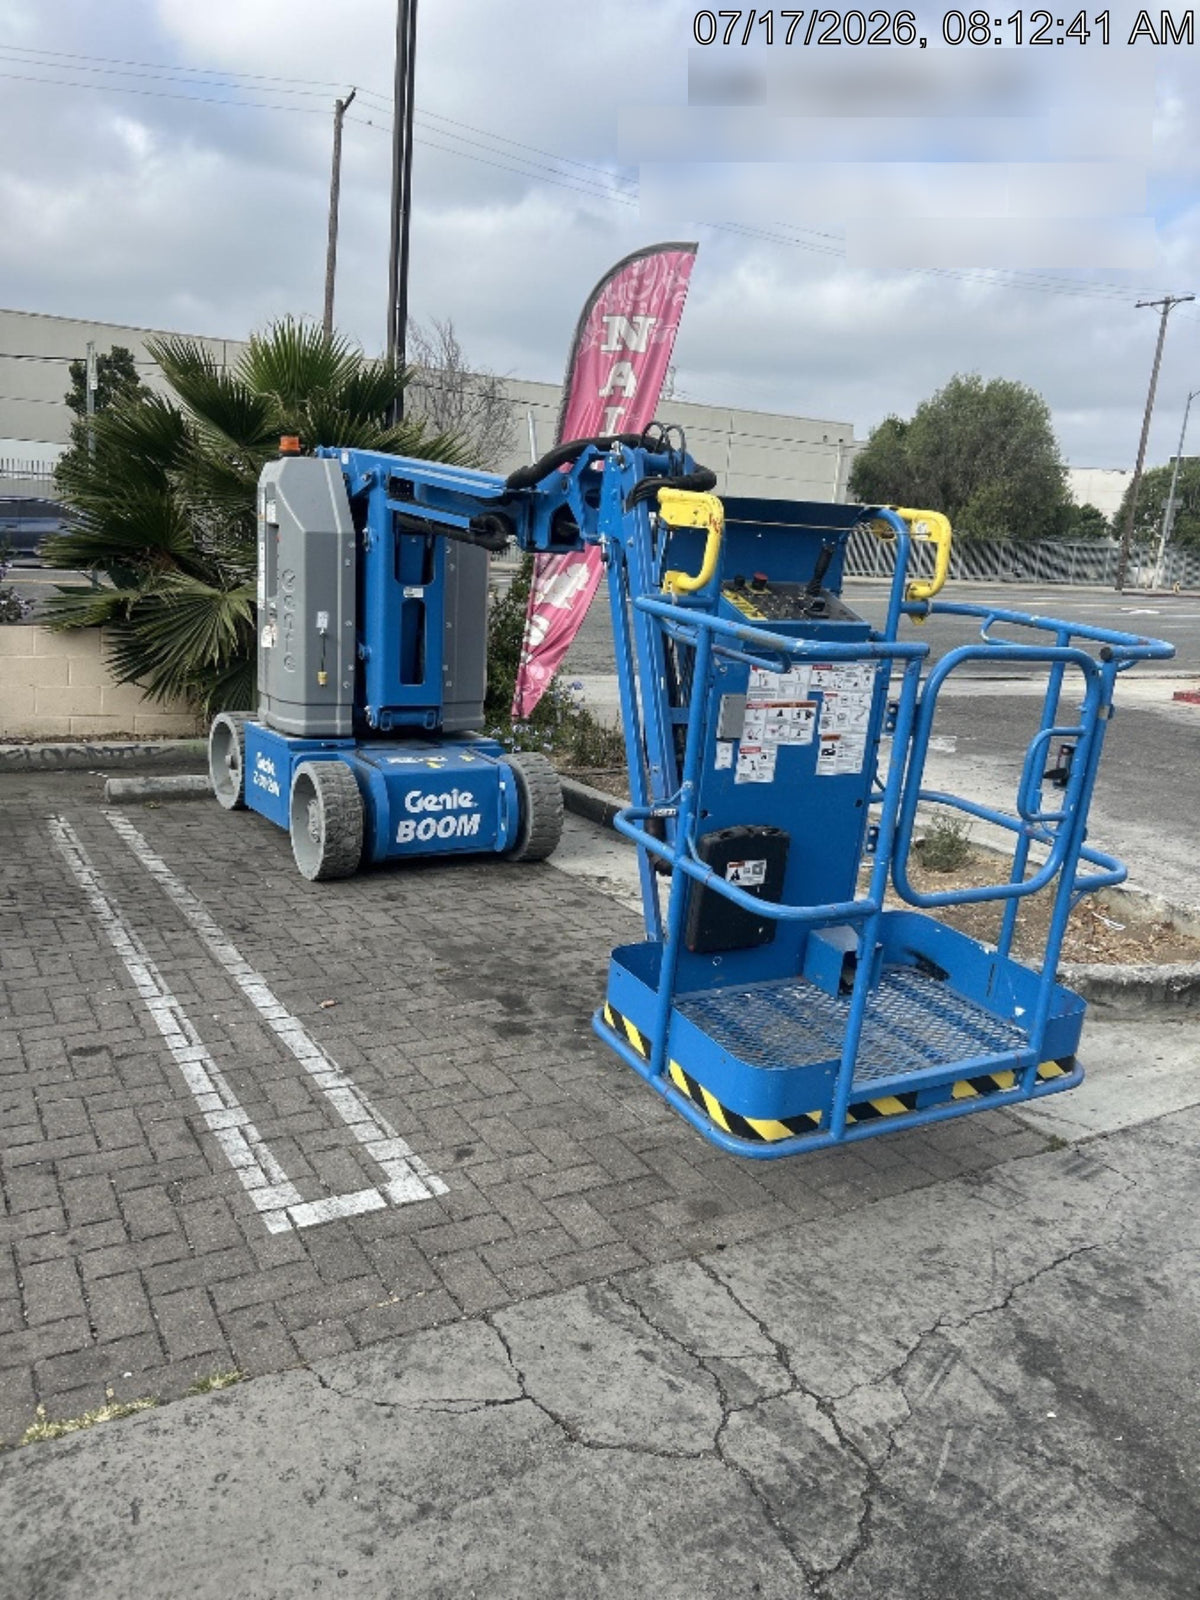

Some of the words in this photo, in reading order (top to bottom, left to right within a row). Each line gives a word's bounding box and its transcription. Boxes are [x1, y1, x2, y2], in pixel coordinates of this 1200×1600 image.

[594, 314, 657, 470] NAI
[281, 568, 296, 673] Genie
[396, 813, 481, 843] BOOM
[404, 787, 474, 813] Genie
